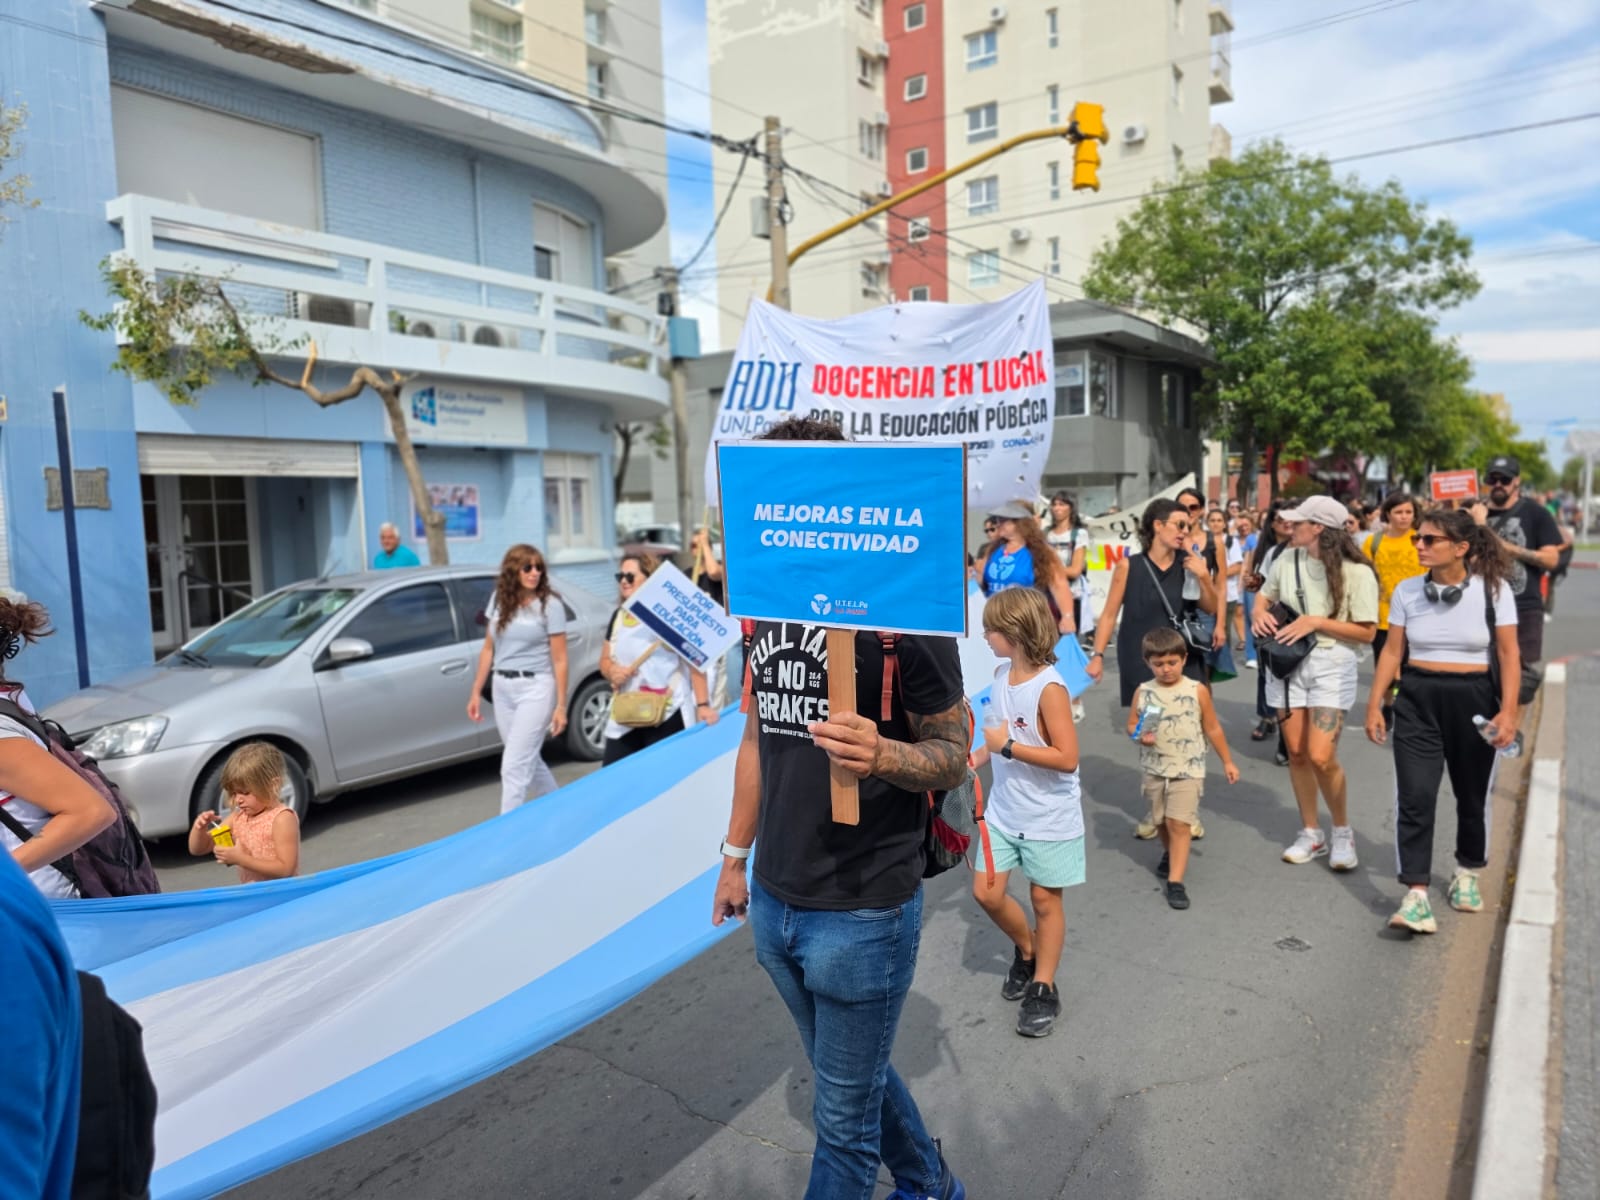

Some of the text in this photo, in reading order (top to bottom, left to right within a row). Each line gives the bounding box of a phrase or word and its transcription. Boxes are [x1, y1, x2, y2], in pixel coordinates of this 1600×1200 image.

[812, 350, 1047, 398] DOCENCIA EN LUCHA
[851, 412, 873, 436] LA
[880, 406, 979, 437] EDUCACIÓN
[753, 503, 924, 527] MEJORAS EN LA
[760, 529, 920, 554] CONECTIVIDAD
[662, 580, 728, 637] PRESUPUESTO
[692, 591, 714, 611] POR
[652, 602, 704, 647] EDUCACIÓN
[672, 605, 699, 629] PARA
[750, 622, 794, 676] FULL
[777, 660, 806, 690] NO
[757, 691, 830, 726] BRAKES
